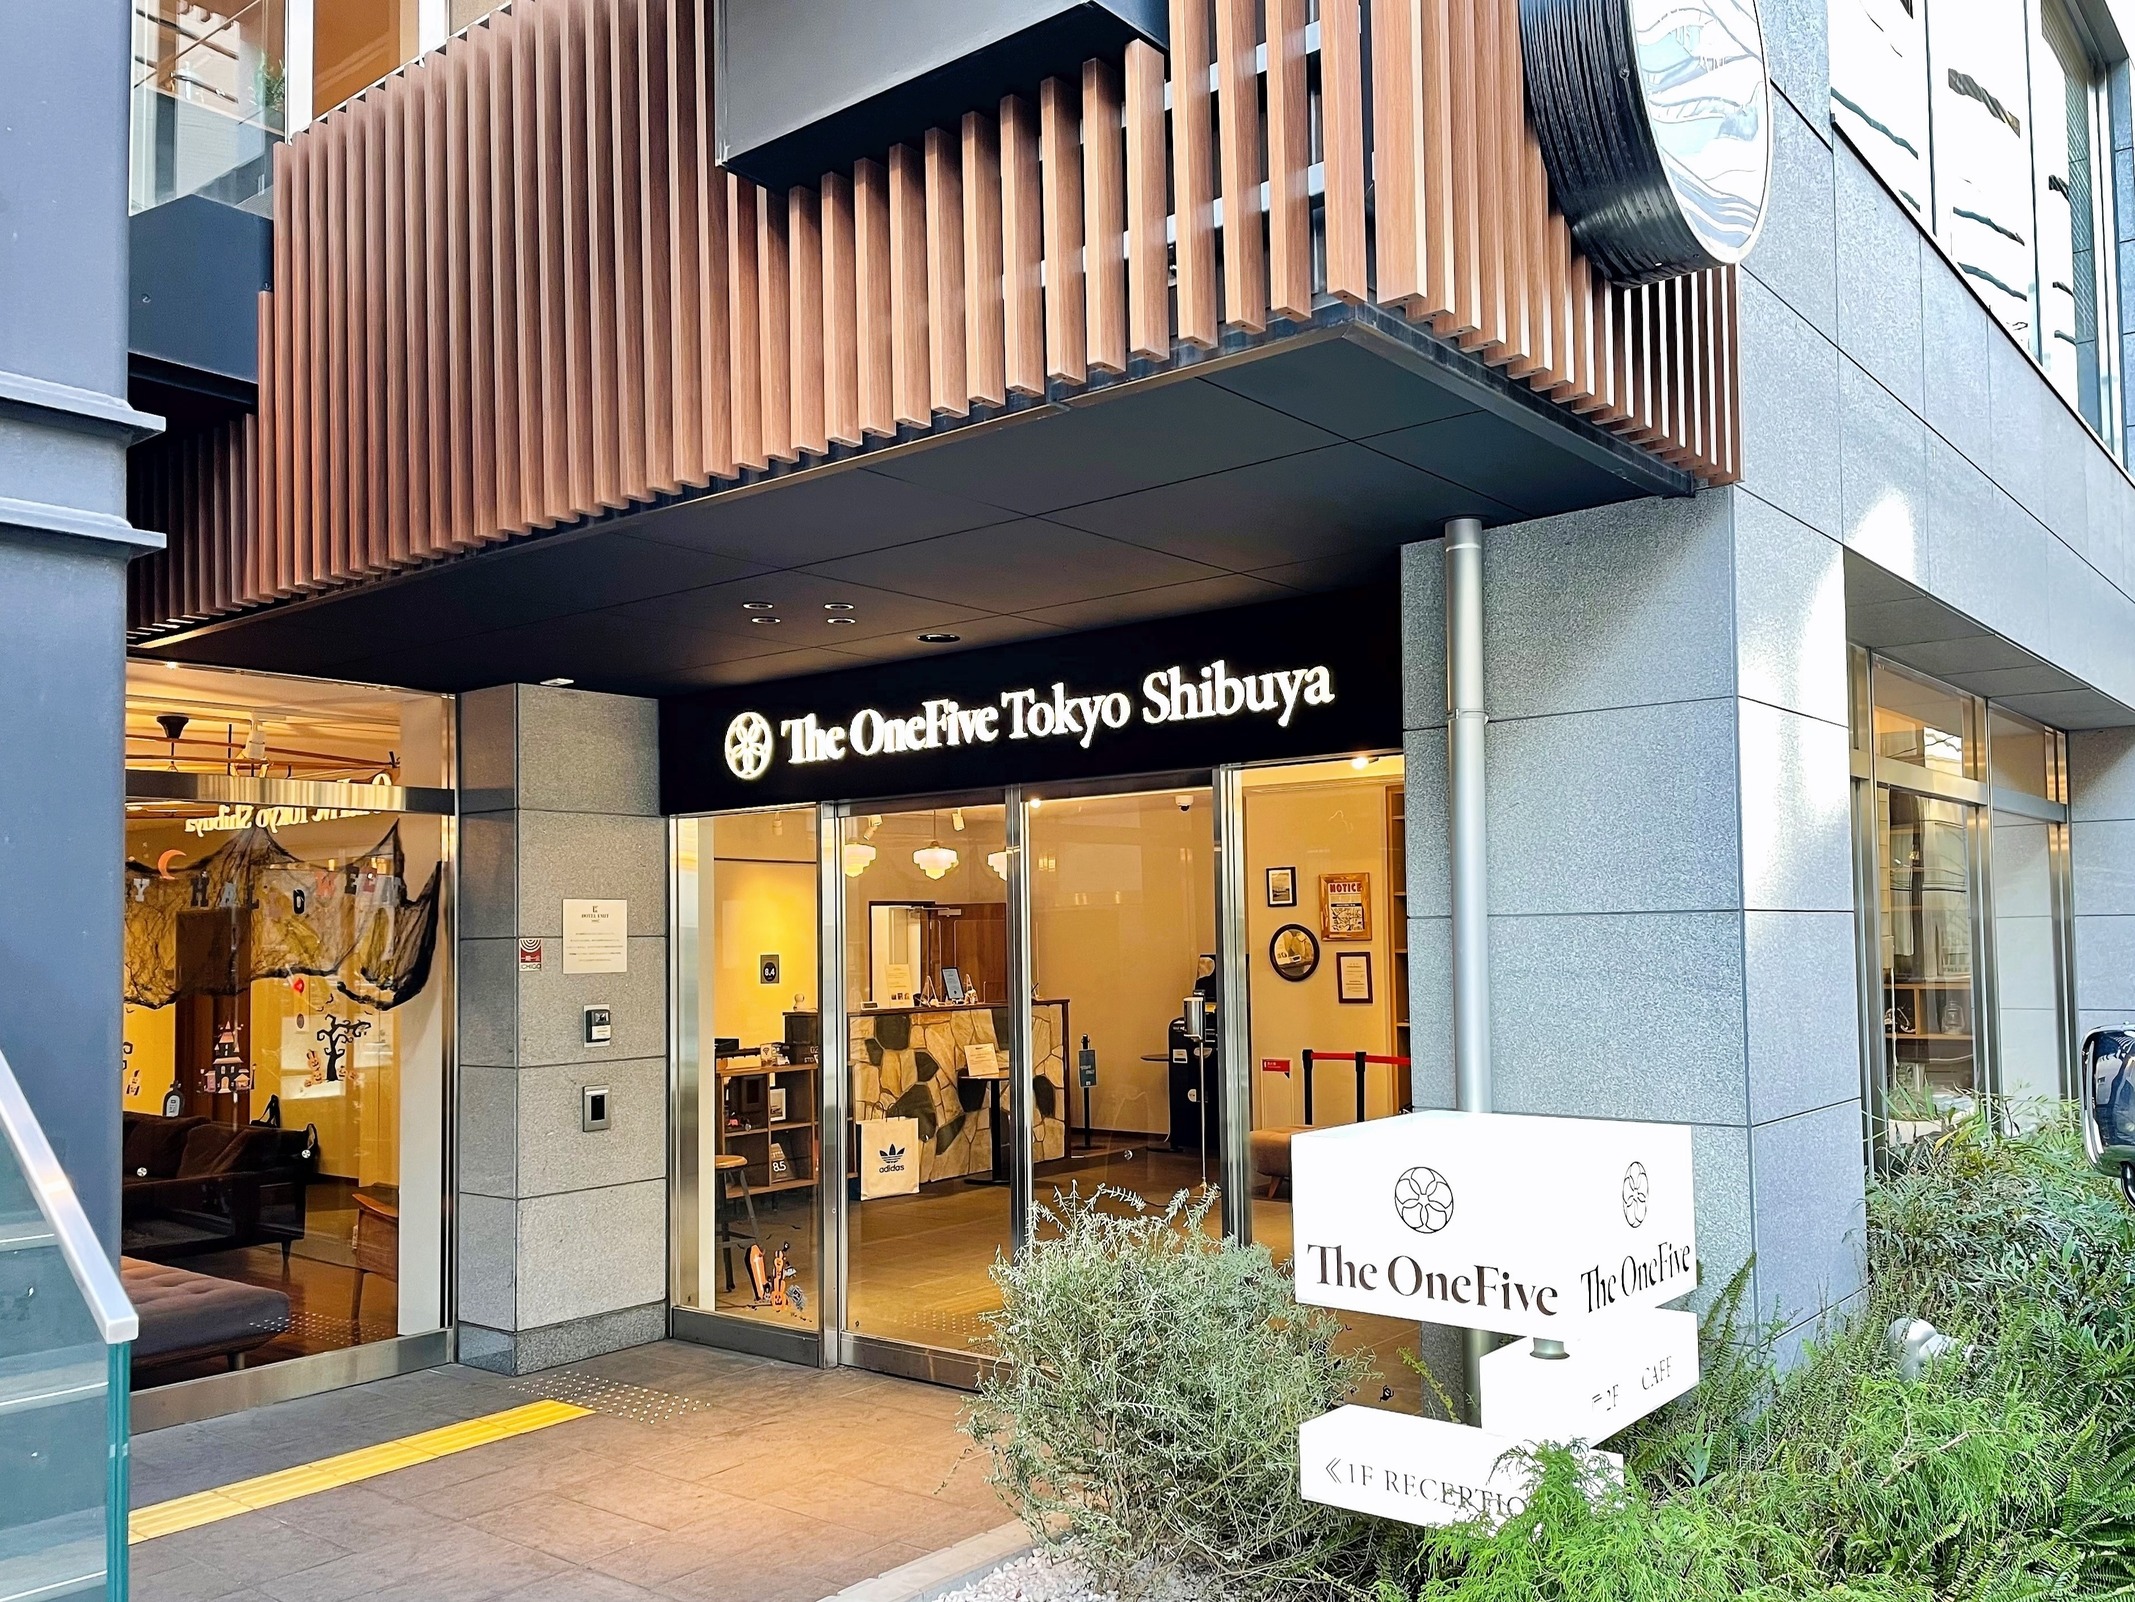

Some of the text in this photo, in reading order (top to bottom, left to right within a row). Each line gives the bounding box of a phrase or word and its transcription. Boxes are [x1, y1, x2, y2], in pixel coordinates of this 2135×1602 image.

[781, 660, 1335, 765] The OneFive Tokyo Shibuya
[1329, 882, 1363, 893] NOTICE
[878, 1164, 906, 1174] adidas
[1307, 1243, 1559, 1317] The OneFive
[1580, 1240, 1692, 1314] The OneFive
[1348, 1463, 1529, 1519] 1F RECEPTIO
